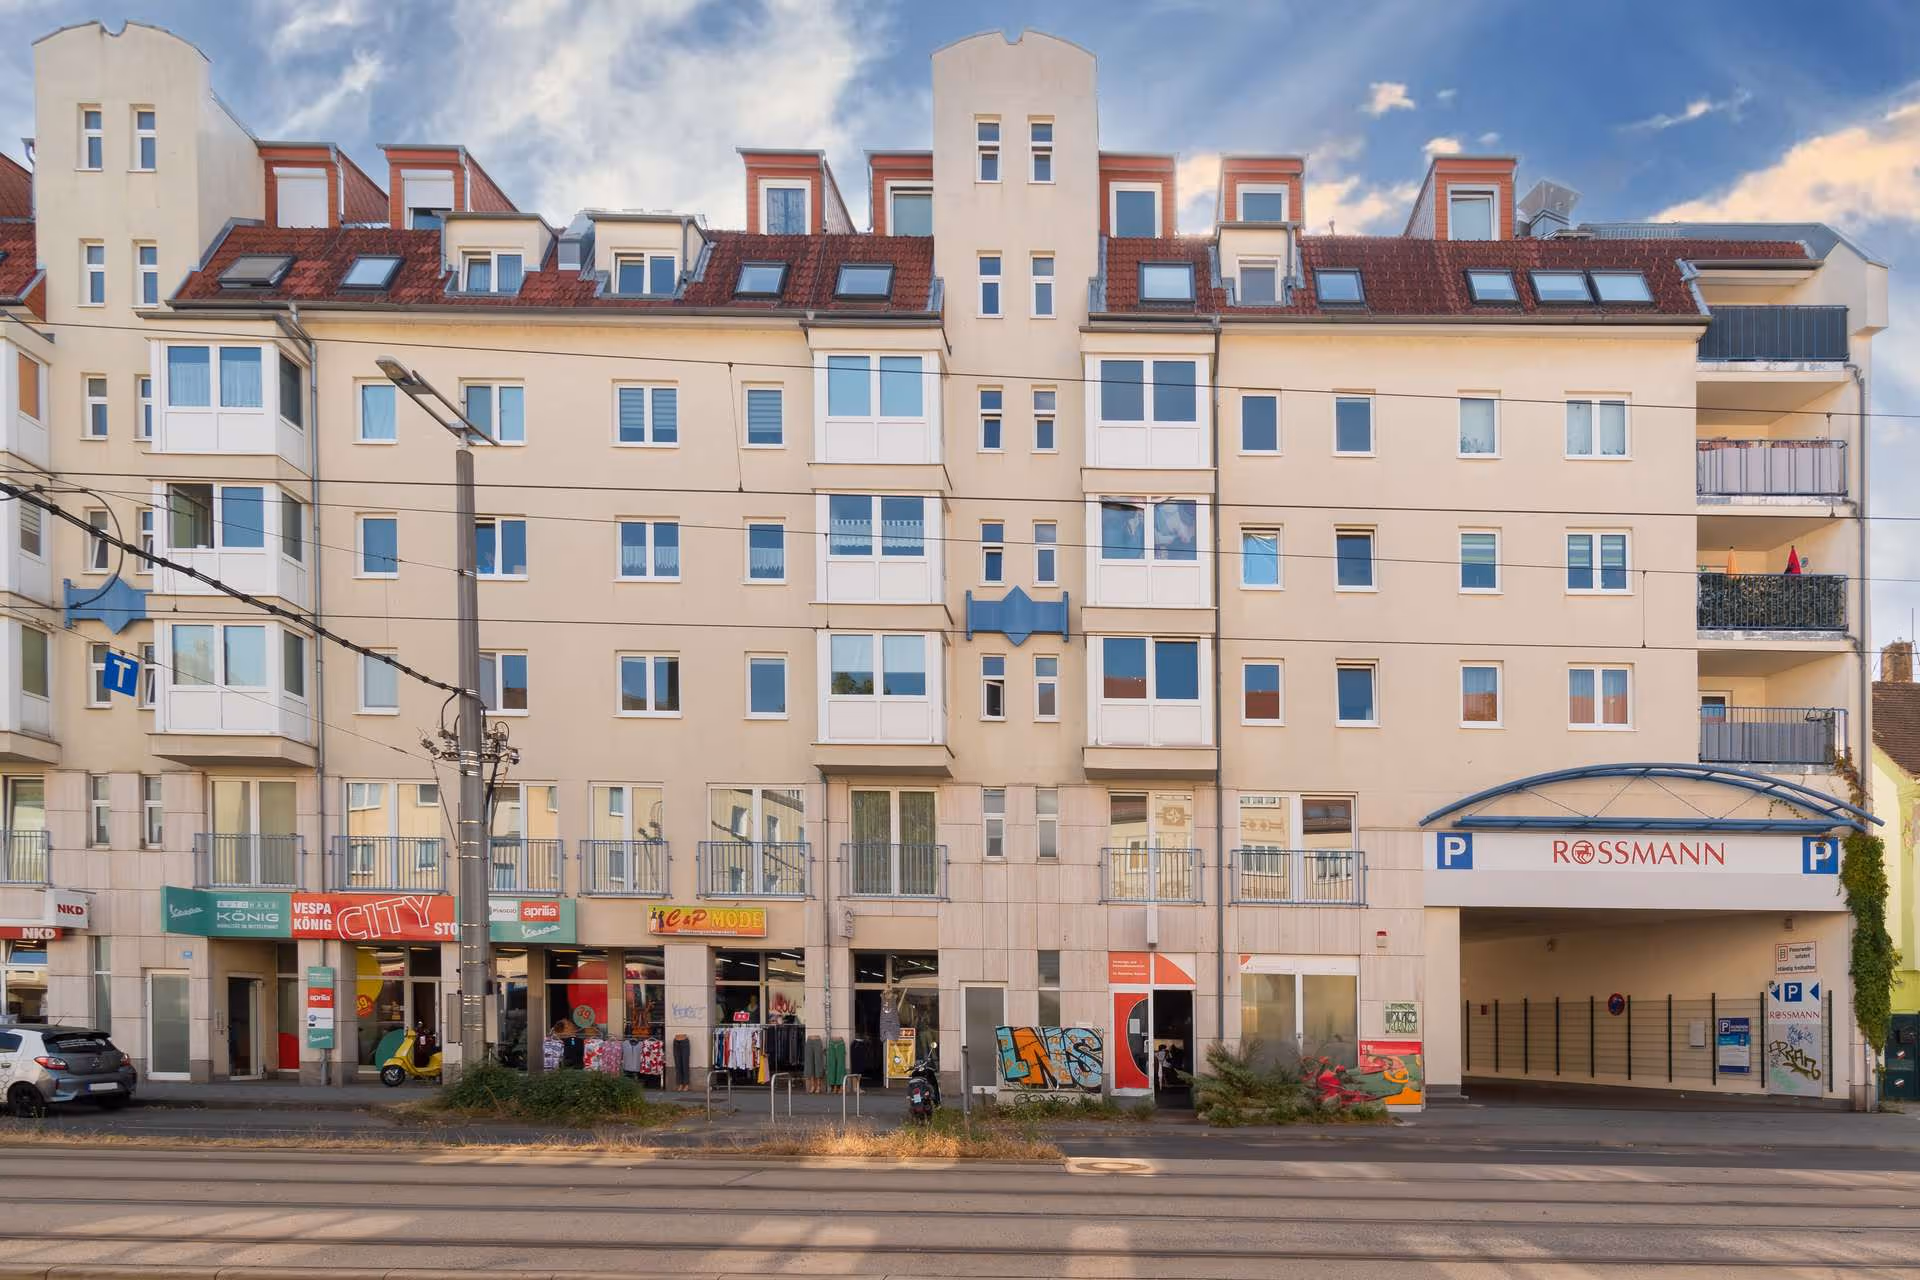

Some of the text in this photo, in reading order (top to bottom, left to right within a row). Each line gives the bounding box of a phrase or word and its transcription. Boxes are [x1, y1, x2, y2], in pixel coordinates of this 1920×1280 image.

[113, 659, 132, 688] T
[1444, 836, 1467, 866] P
[1552, 839, 1726, 866] ROSSMANN
[1810, 841, 1832, 870] P
[57, 903, 84, 916] NKD
[169, 904, 205, 919] Vespa
[294, 902, 332, 915] VESPA
[524, 905, 557, 918] aprilia
[216, 910, 280, 922] KÖNIG
[294, 916, 332, 930] KÖNIG
[336, 896, 433, 940] CITY
[711, 911, 764, 928] MODE
[22, 928, 56, 939] NKD
[434, 922, 463, 936] STO
[521, 925, 560, 938] Vespa
[1788, 985, 1799, 1000] P
[1769, 1010, 1820, 1020] ROSSMANN
[1721, 1022, 1729, 1032] P
